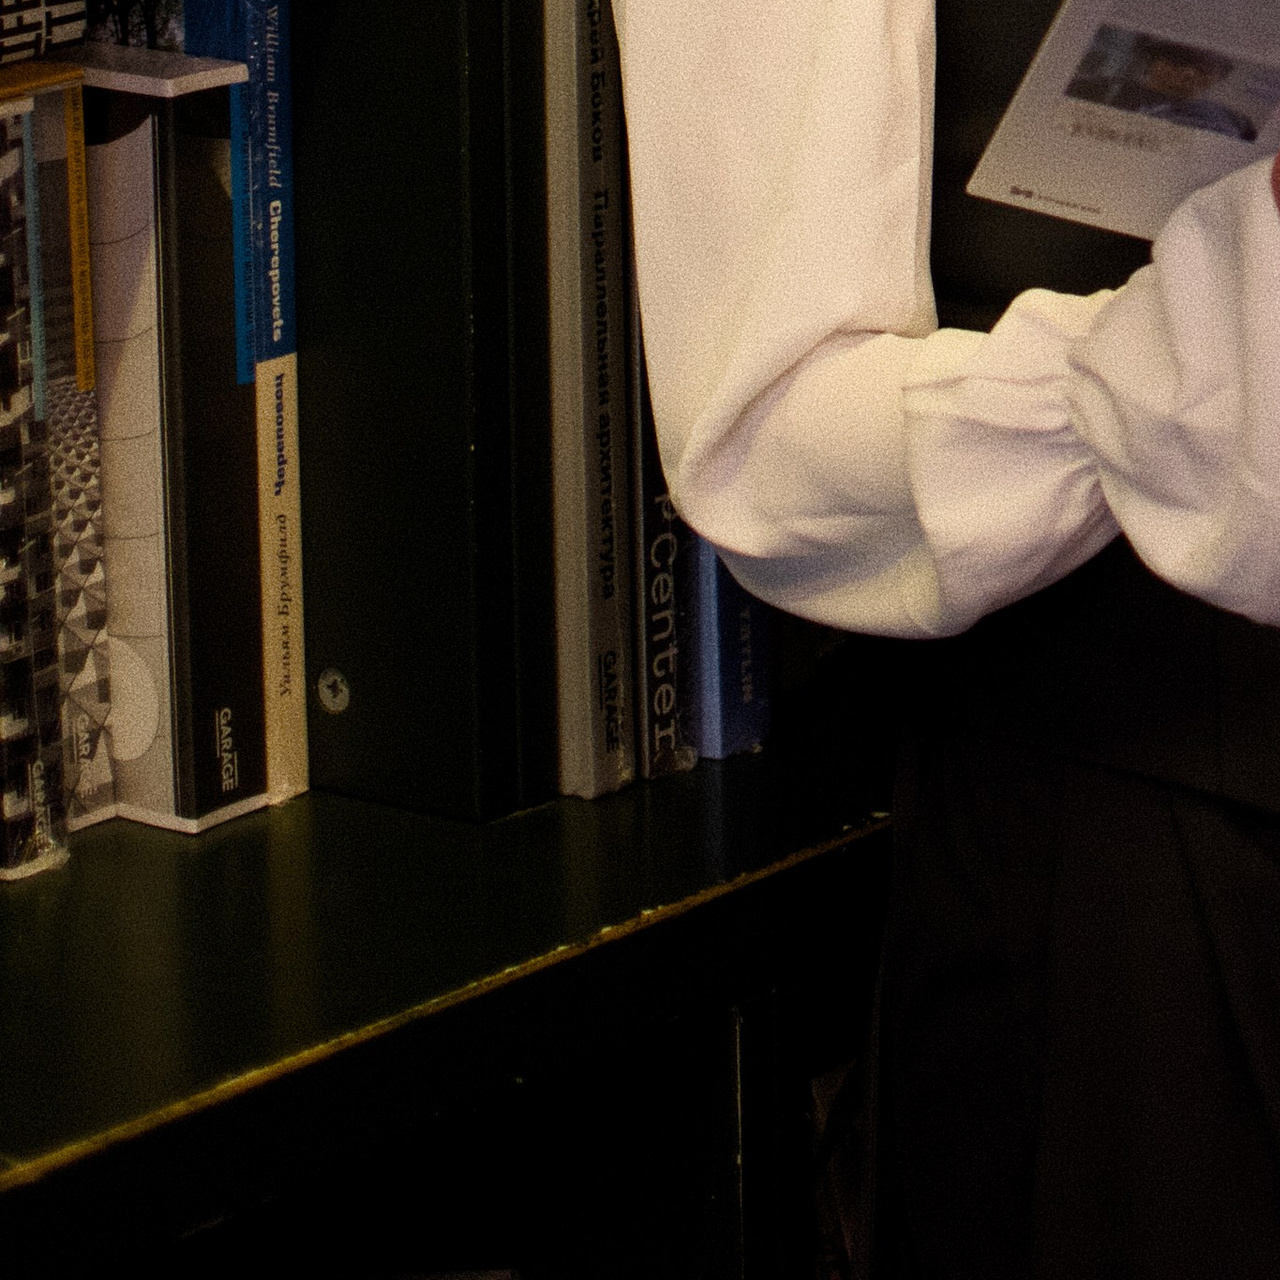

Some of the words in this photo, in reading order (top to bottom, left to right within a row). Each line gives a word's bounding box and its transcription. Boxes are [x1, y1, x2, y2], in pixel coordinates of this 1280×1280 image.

[264, 4, 280, 83] William
[264, 90, 283, 189] Brumfield
[267, 199, 286, 344] Cherepovets
[594, 414, 617, 599] архитектура
[218, 706, 236, 794] GARAGE
[602, 649, 620, 753] GARAGE
